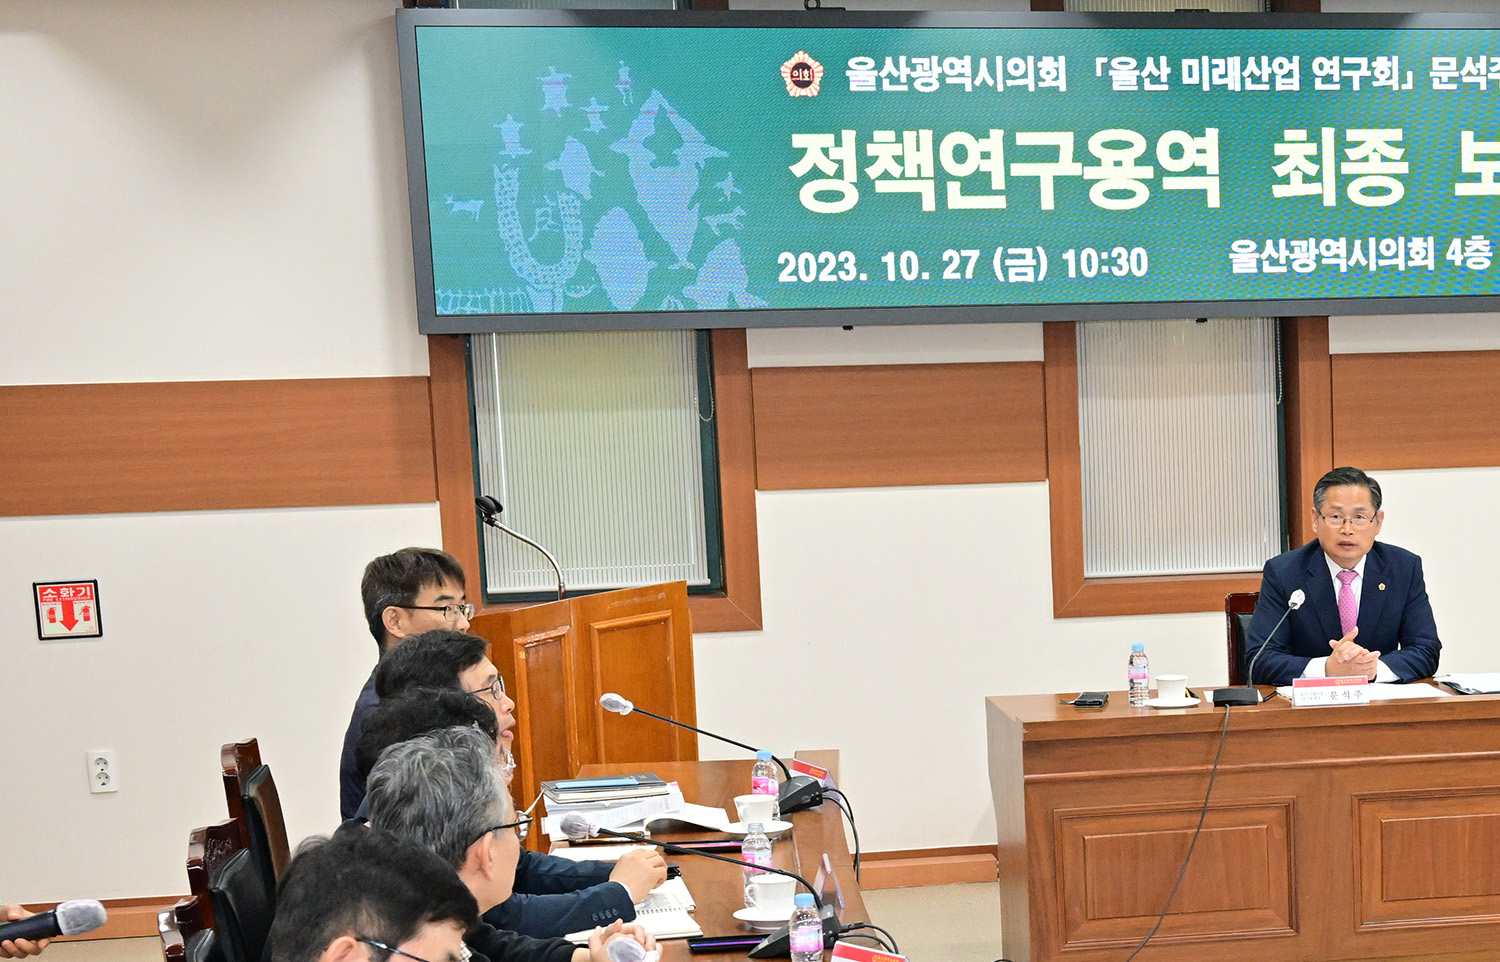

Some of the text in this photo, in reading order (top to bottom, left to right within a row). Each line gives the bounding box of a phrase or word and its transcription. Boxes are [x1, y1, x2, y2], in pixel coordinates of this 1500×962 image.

[845, 55, 1067, 92] 울산광역시의회
[1095, 55, 1171, 92] 「울산
[1181, 55, 1300, 92] 미래산업
[1311, 55, 1414, 91] 연구회」
[788, 127, 1220, 214] 정책연구용역
[1271, 127, 1409, 207] 최종
[777, 250, 868, 283] 2023.
[881, 250, 930, 282] 10.
[942, 249, 980, 280] 27
[992, 245, 1048, 283] (금)
[1062, 246, 1149, 278] 10:30
[1228, 236, 1435, 274] 울산광역시의회
[1445, 235, 1493, 270] 4층
[42, 586, 90, 598] 소화기
[1330, 690, 1363, 700] 문석주
